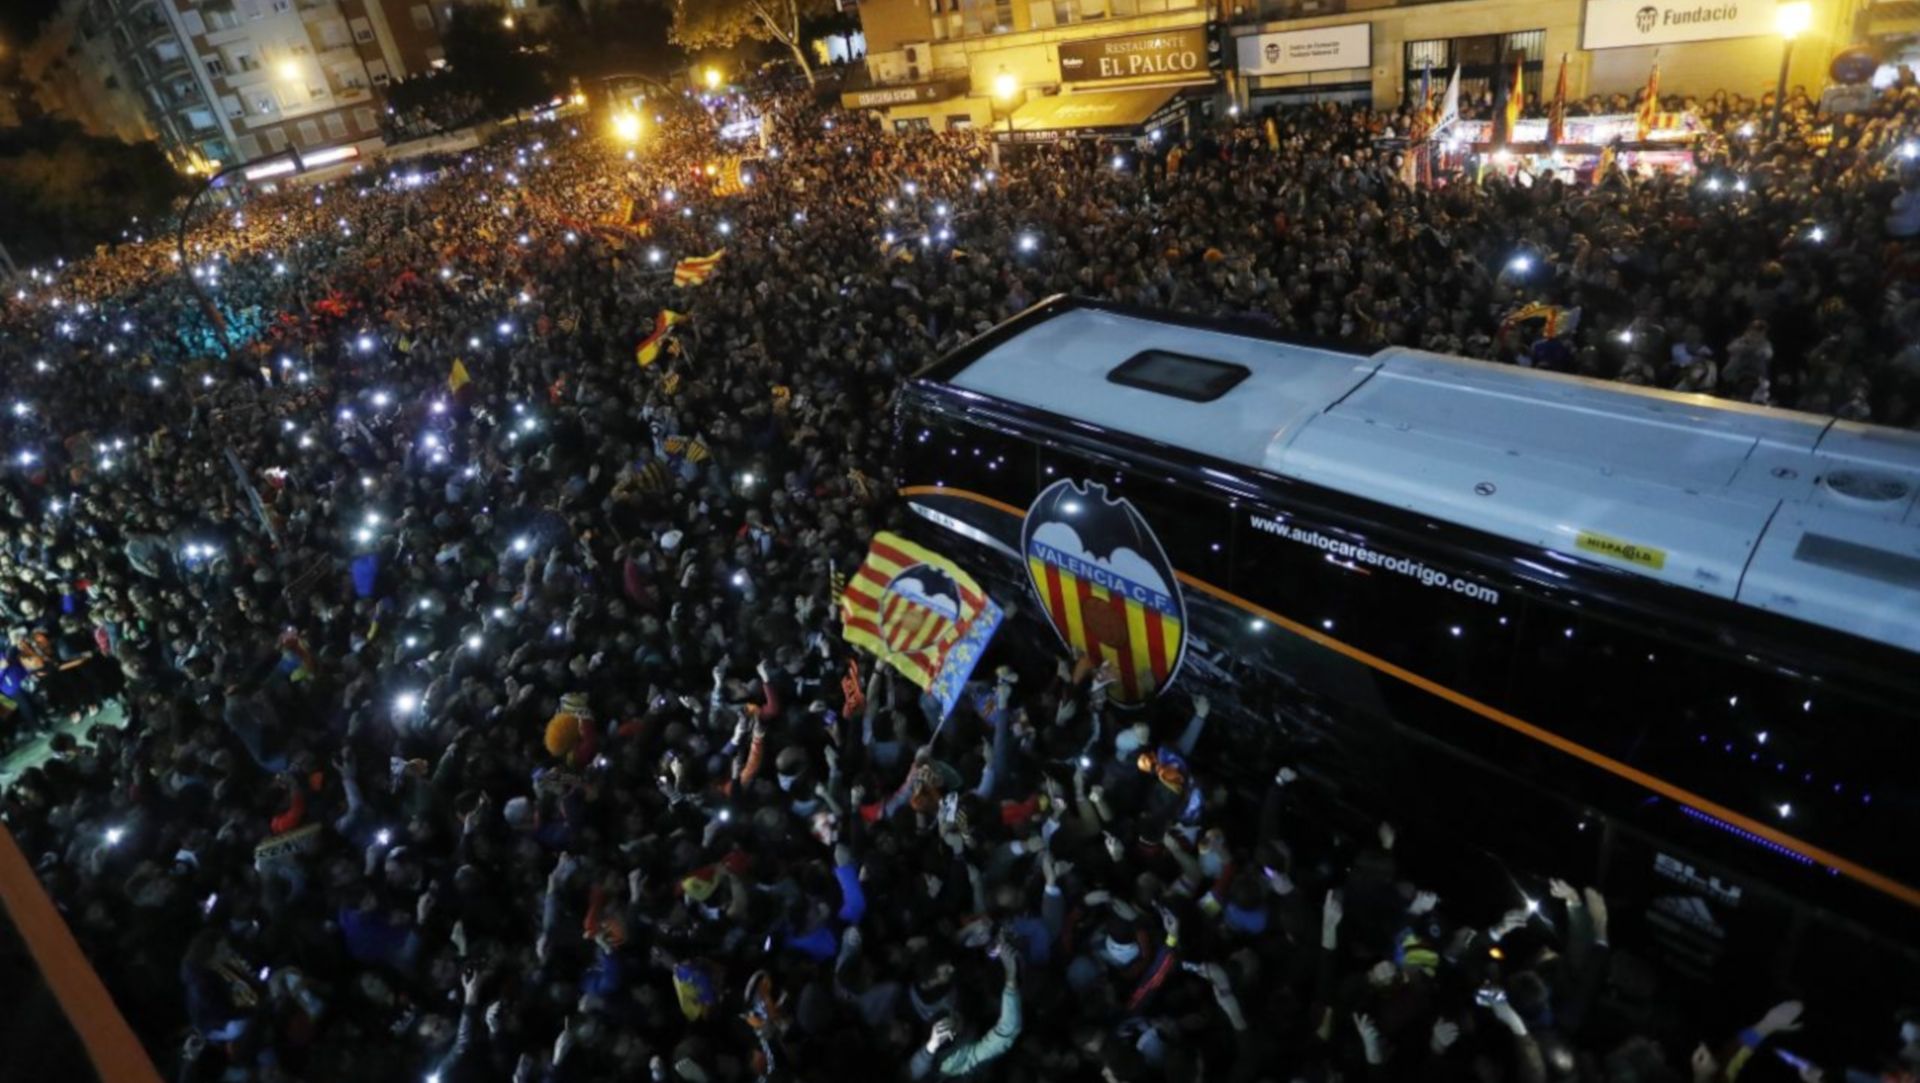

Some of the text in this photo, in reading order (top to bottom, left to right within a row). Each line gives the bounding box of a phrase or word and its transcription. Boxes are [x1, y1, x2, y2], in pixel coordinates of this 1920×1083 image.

[1663, 4, 1737, 26] Fundació
[1105, 36, 1187, 55] RESTAURANTE
[1099, 57, 1125, 77] EL
[1128, 51, 1198, 75] PALCO
[1249, 514, 1499, 605] www.autocaresrodrigo.com
[1034, 543, 1173, 613] VALENCIA C.F.
